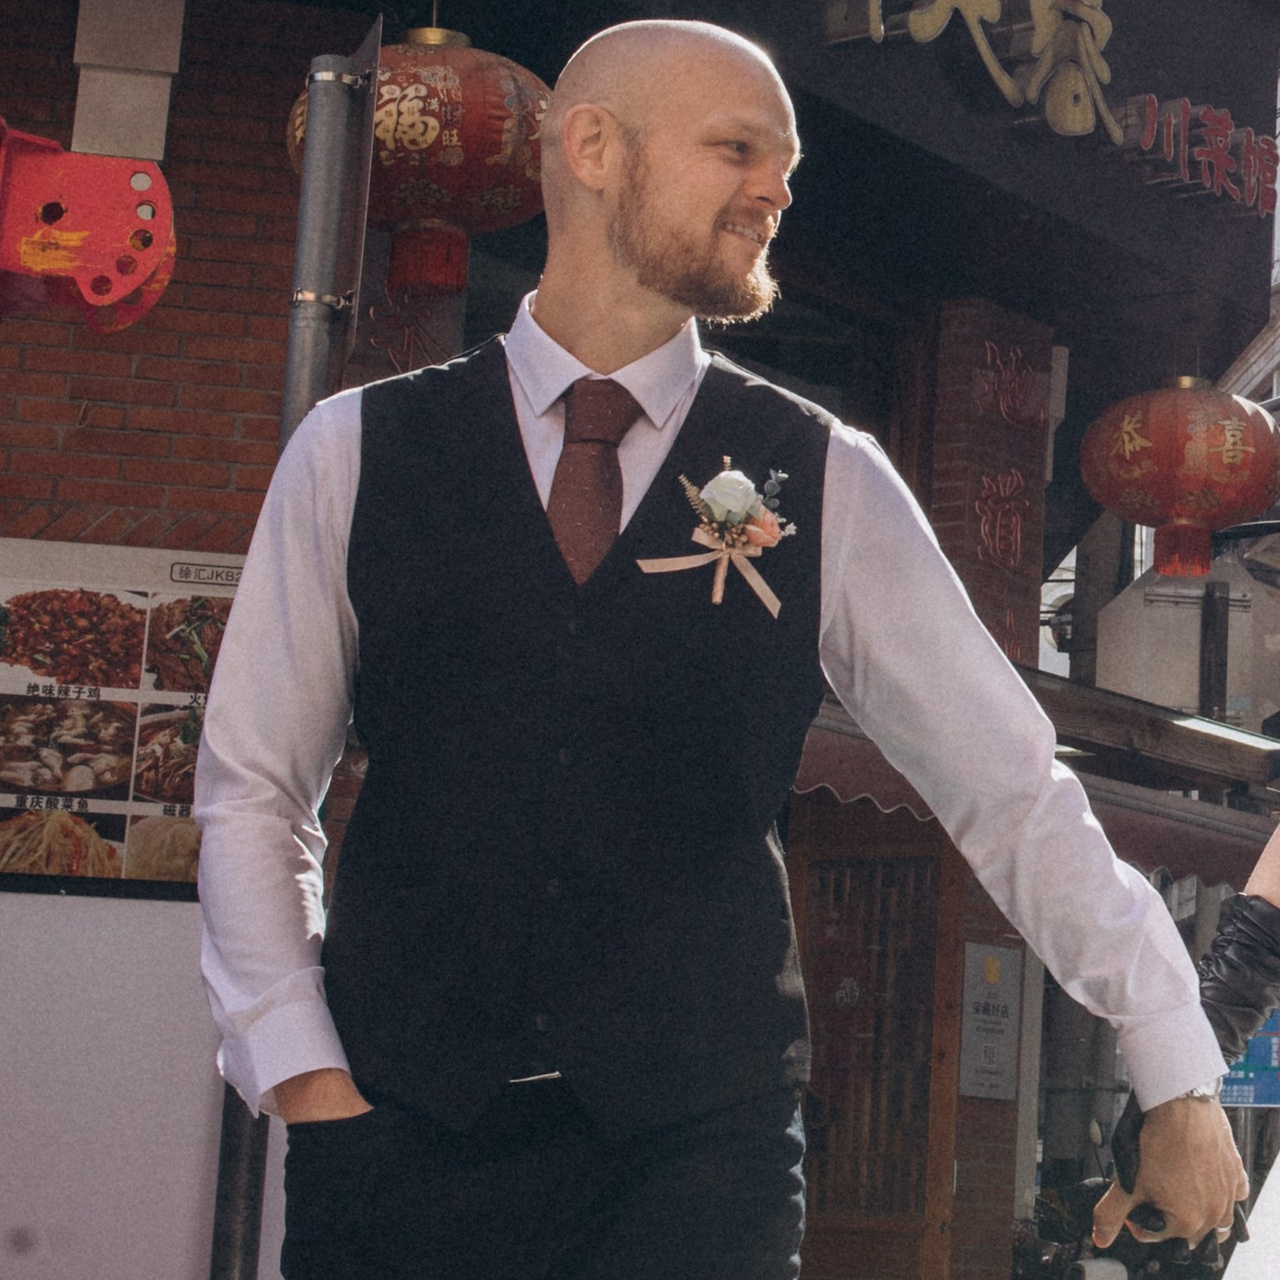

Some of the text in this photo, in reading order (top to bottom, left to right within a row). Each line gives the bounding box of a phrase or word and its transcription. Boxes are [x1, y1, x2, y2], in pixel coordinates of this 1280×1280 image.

[375, 83, 441, 150] 福
[26, 683, 101, 700] 绝味辣子鸡
[14, 794, 90, 812] 重庆酸菜鱼
